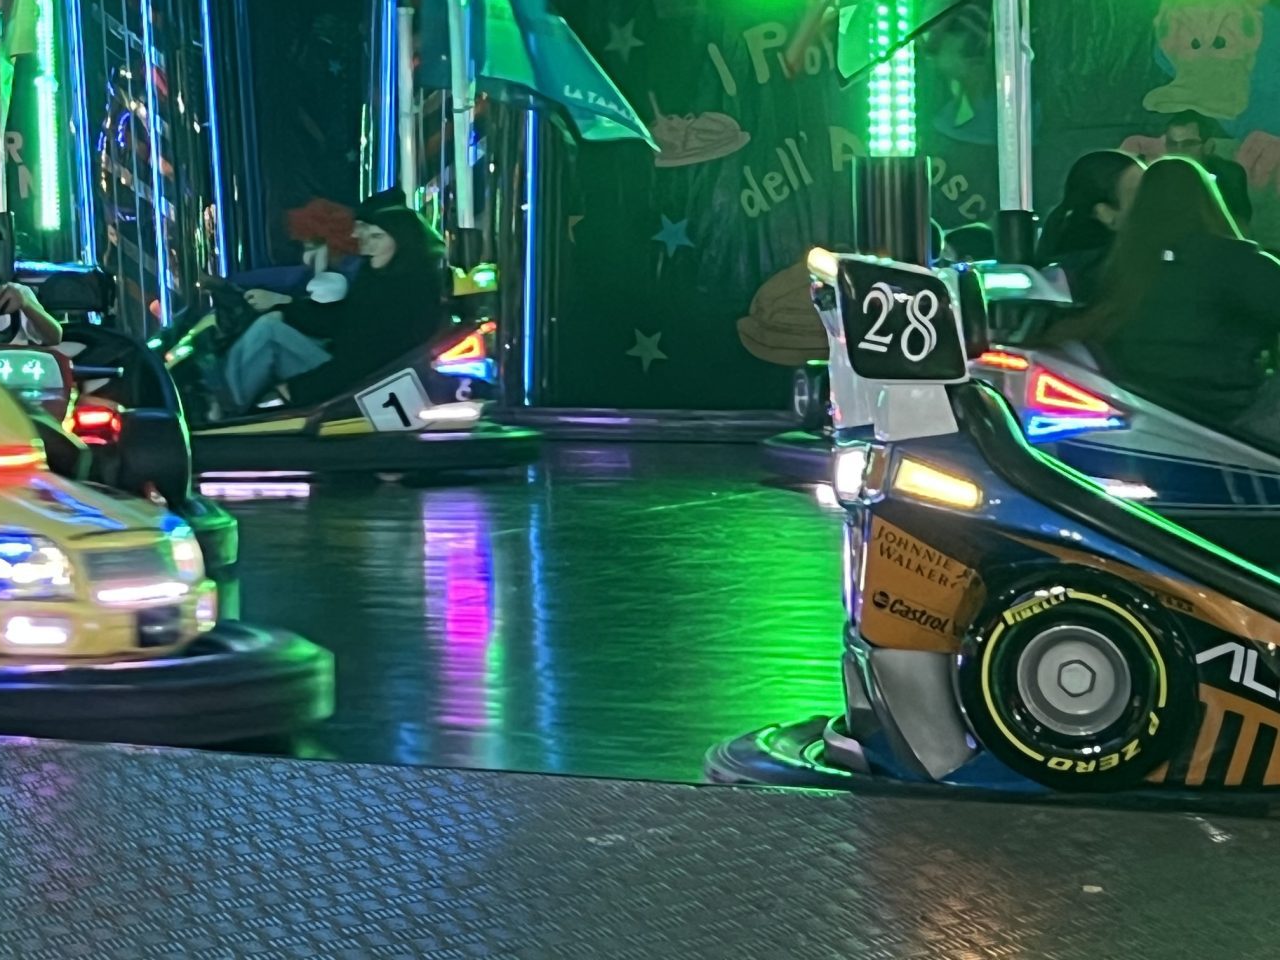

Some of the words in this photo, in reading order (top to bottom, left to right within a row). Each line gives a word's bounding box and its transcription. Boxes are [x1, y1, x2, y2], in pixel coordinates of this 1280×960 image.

[857, 281, 939, 362] 28
[381, 391, 412, 428] 1
[875, 525, 952, 571] JOHNNIE
[879, 542, 949, 588] WALKER
[889, 598, 951, 634] Castrol
[1046, 738, 1142, 773] ZERO
